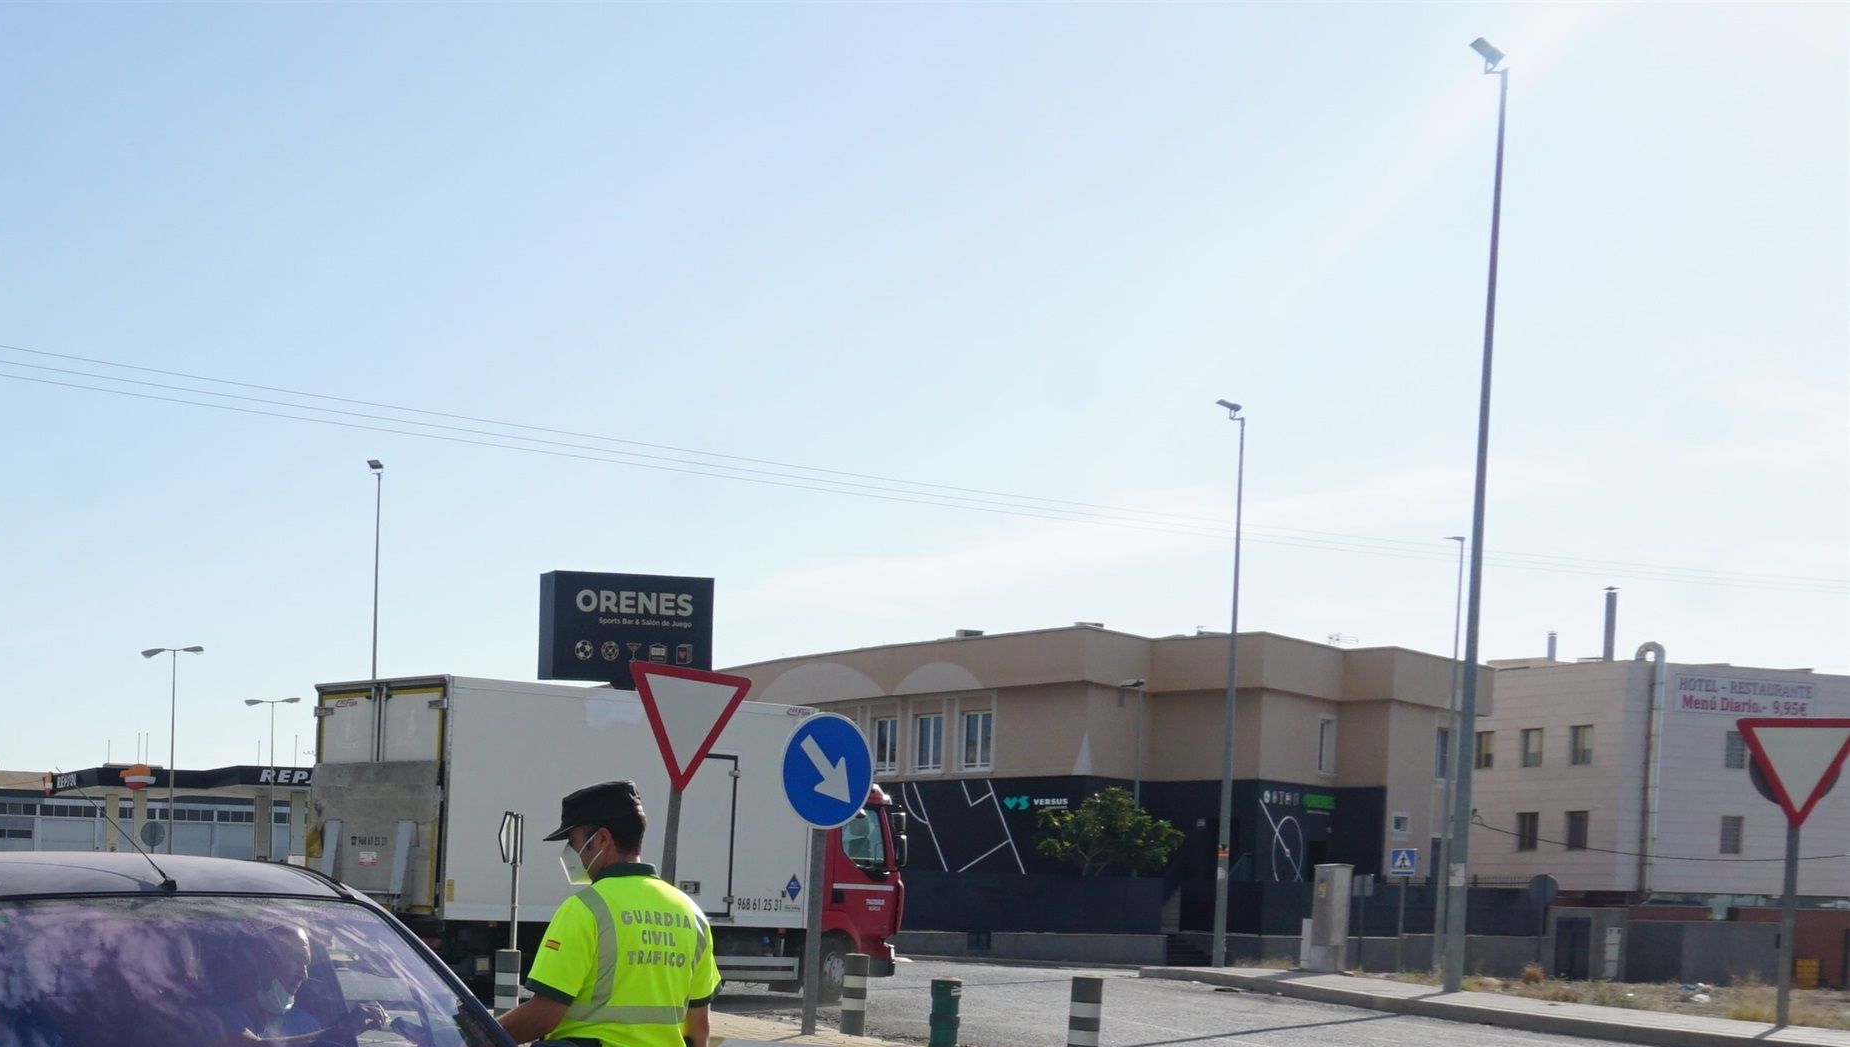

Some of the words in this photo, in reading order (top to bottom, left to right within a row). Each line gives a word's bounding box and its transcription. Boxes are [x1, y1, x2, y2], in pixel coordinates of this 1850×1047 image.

[575, 588, 694, 617] ORENES
[598, 617, 621, 625] Sports
[641, 618, 661, 627] Salón
[661, 619, 670, 627] de
[671, 620, 693, 629] Juego
[1679, 677, 1718, 693] HOTEL
[1730, 680, 1813, 699] RESTAURANTE
[1682, 694, 1717, 711] Menú
[1772, 700, 1808, 717] 9,95€
[259, 769, 312, 784] REP
[1033, 798, 1068, 806] VERSUS
[737, 897, 750, 911] 968
[752, 897, 761, 911] 61
[763, 898, 772, 911] 25
[774, 898, 782, 911] 31
[621, 910, 691, 929] GUARDIA
[641, 929, 676, 947] CIVIL
[627, 950, 686, 968] TRAFICO
